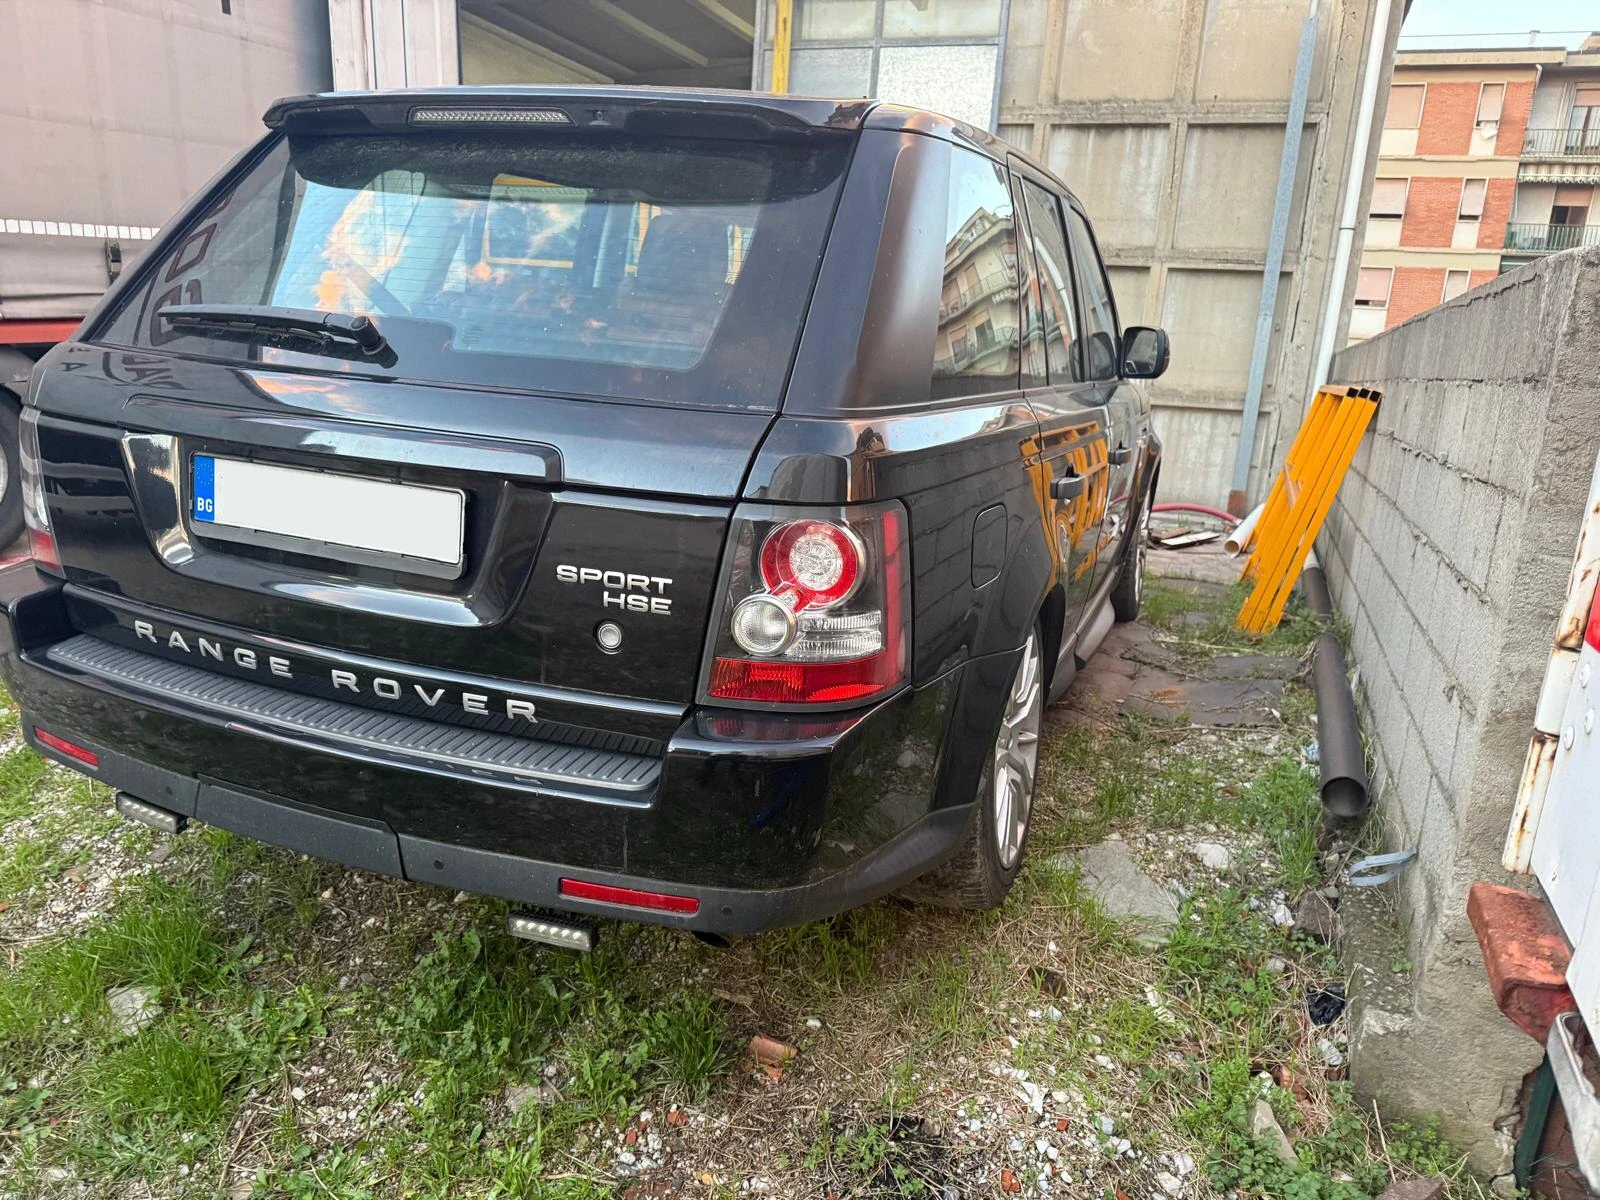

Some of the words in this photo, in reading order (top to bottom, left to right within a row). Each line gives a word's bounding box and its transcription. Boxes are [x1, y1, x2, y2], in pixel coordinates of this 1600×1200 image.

[197, 496, 213, 513] BG
[556, 564, 673, 594] SPORT
[603, 591, 673, 615] HSE
[134, 619, 294, 679] RANGE
[331, 669, 539, 724] ROVER
